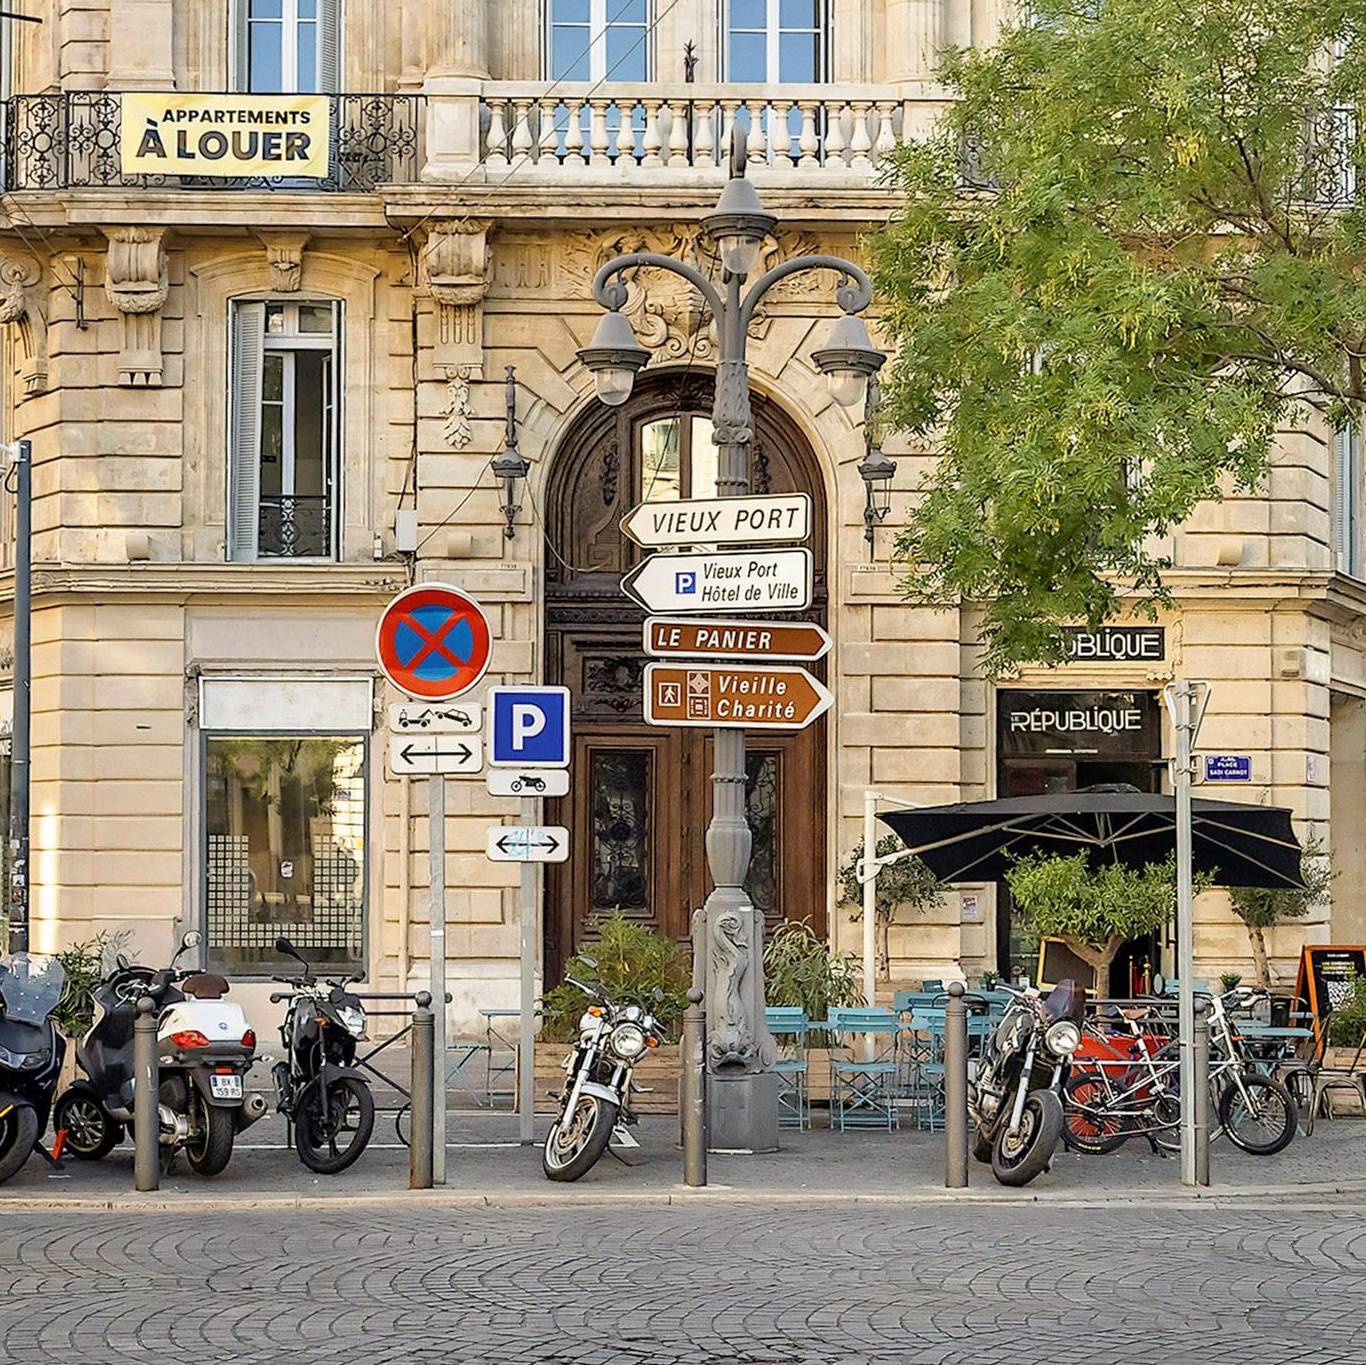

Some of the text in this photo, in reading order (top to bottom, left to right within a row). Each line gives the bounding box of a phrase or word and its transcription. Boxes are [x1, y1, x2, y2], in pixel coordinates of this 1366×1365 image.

[162, 109, 311, 124] APPARTEMENTS
[135, 118, 311, 161] À LOUER
[653, 507, 799, 534] VIEUX PORT
[703, 561, 778, 579] Vieux Port
[701, 583, 799, 602] Hôtel de Ville
[657, 628, 772, 650] LE PANIER
[718, 676, 787, 695] Vieille
[717, 699, 795, 719] Charité
[512, 703, 546, 751] P
